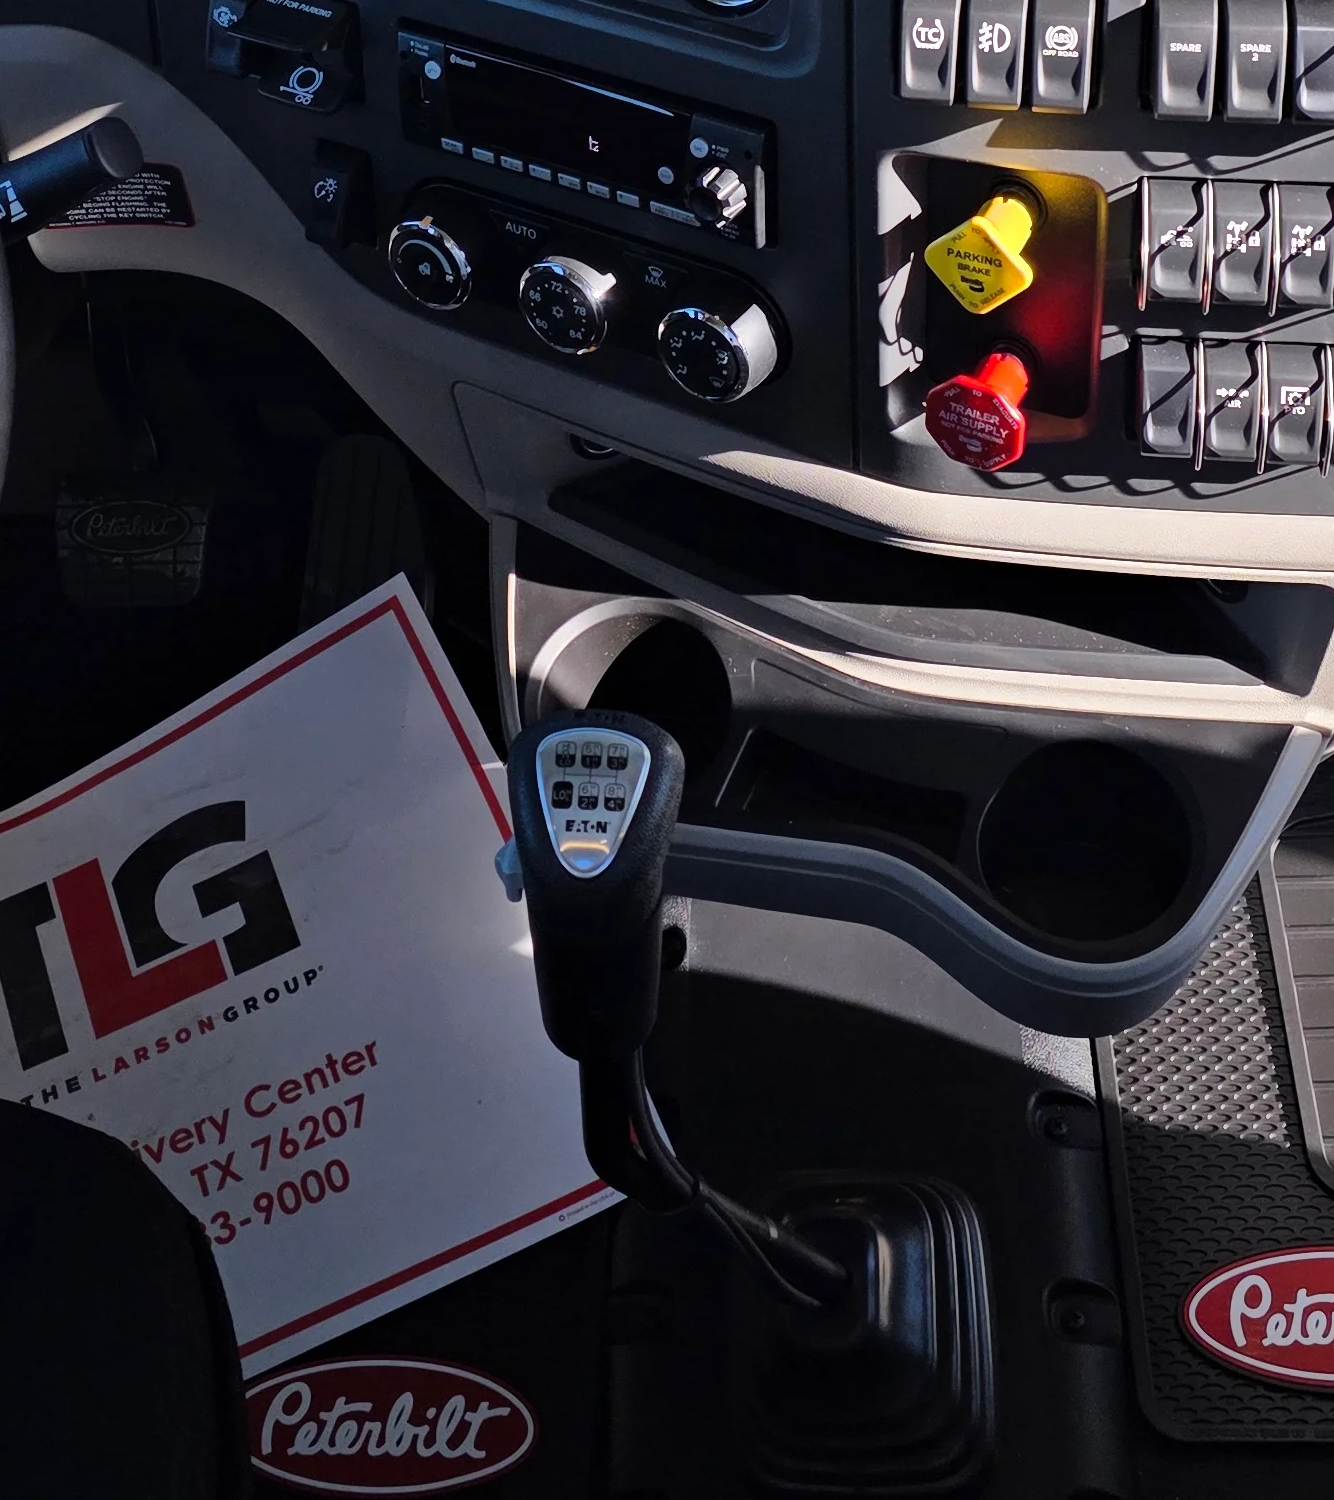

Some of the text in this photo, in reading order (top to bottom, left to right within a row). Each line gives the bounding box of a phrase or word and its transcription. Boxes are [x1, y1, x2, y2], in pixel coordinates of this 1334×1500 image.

[284, 0, 300, 10] FOR
[299, 2, 333, 19] PARKING
[917, 26, 940, 43] TC
[1053, 32, 1071, 45] ABS
[1042, 49, 1079, 58] OFF ROAD
[1169, 42, 1202, 53] SPARE
[1240, 43, 1272, 54] SPARE
[1251, 53, 1259, 62] 2
[505, 221, 537, 240] AUTO
[947, 247, 1003, 268] PARKING
[957, 262, 992, 277] BRAKE
[550, 280, 563, 293] 72
[645, 275, 667, 288] MAX
[529, 290, 542, 302] 66
[573, 304, 586, 316] 78
[535, 318, 548, 330] 60
[569, 329, 583, 340] 84
[949, 401, 1001, 426] TRAILER
[938, 409, 1010, 439] AIR SUPPLY
[243, 1040, 378, 1119] Center
[20, 1076, 82, 1108] THE
[189, 1093, 366, 1198] TX 76207
[261, 1380, 511, 1460] Peterbilt
